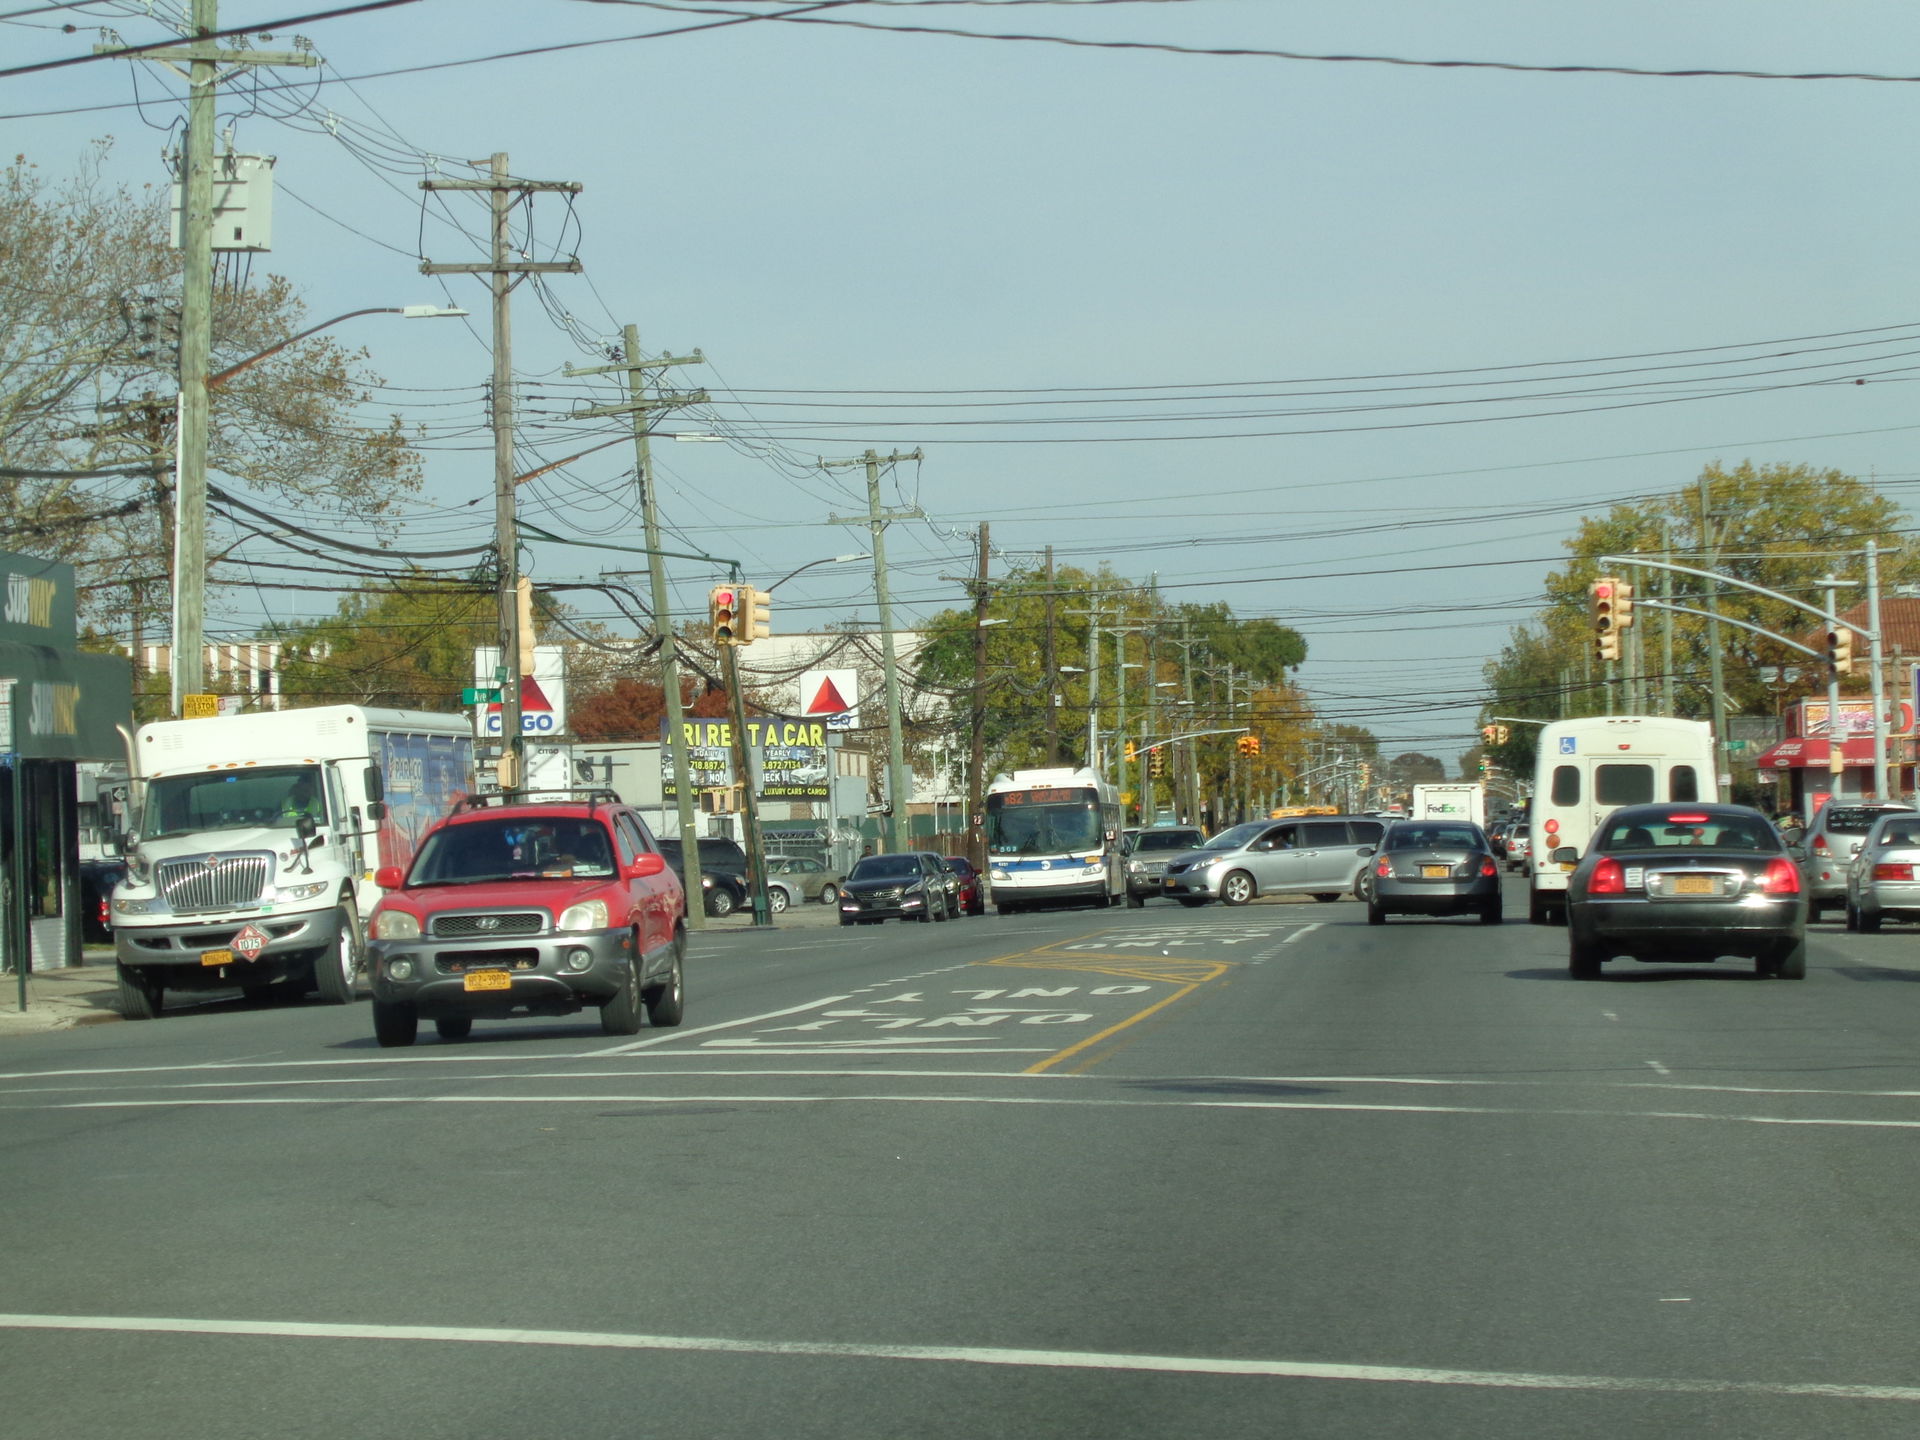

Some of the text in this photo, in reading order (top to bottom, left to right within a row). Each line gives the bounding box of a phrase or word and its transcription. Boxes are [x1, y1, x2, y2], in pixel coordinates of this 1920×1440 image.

[4, 572, 56, 628] SUBWAY
[474, 690, 487, 702] Ave
[29, 681, 80, 735] SUBWAY
[487, 714, 553, 732] CGO
[706, 723, 760, 746] RET
[765, 724, 779, 746] A
[783, 724, 824, 747] CAR
[764, 787, 786, 796] LUXURY
[807, 787, 827, 796] CARGO
[1427, 803, 1456, 813] FedEx
[240, 938, 260, 949] 1075
[1064, 938, 1254, 950] ONLY
[868, 984, 1152, 1004] ONLY
[752, 1012, 1094, 1032] ONLY
